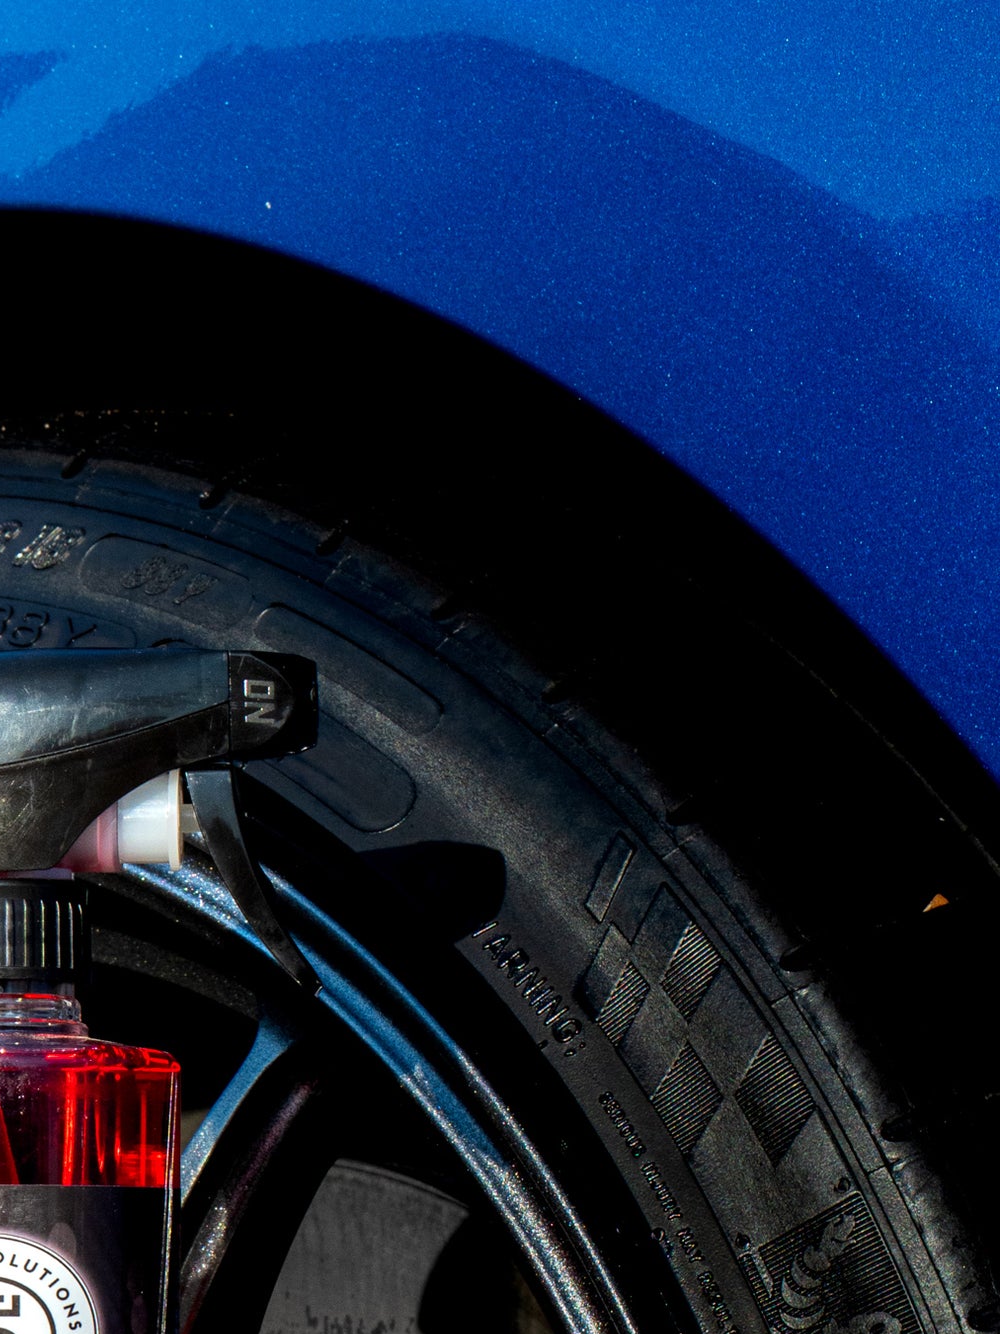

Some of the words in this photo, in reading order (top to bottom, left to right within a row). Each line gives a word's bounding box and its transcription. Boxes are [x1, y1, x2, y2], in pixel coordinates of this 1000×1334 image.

[471, 921, 586, 1057] ARNING:
[598, 1090, 647, 1159] SERIOUS
[640, 1160, 684, 1223] INJURY
[675, 1227, 706, 1264] MAY
